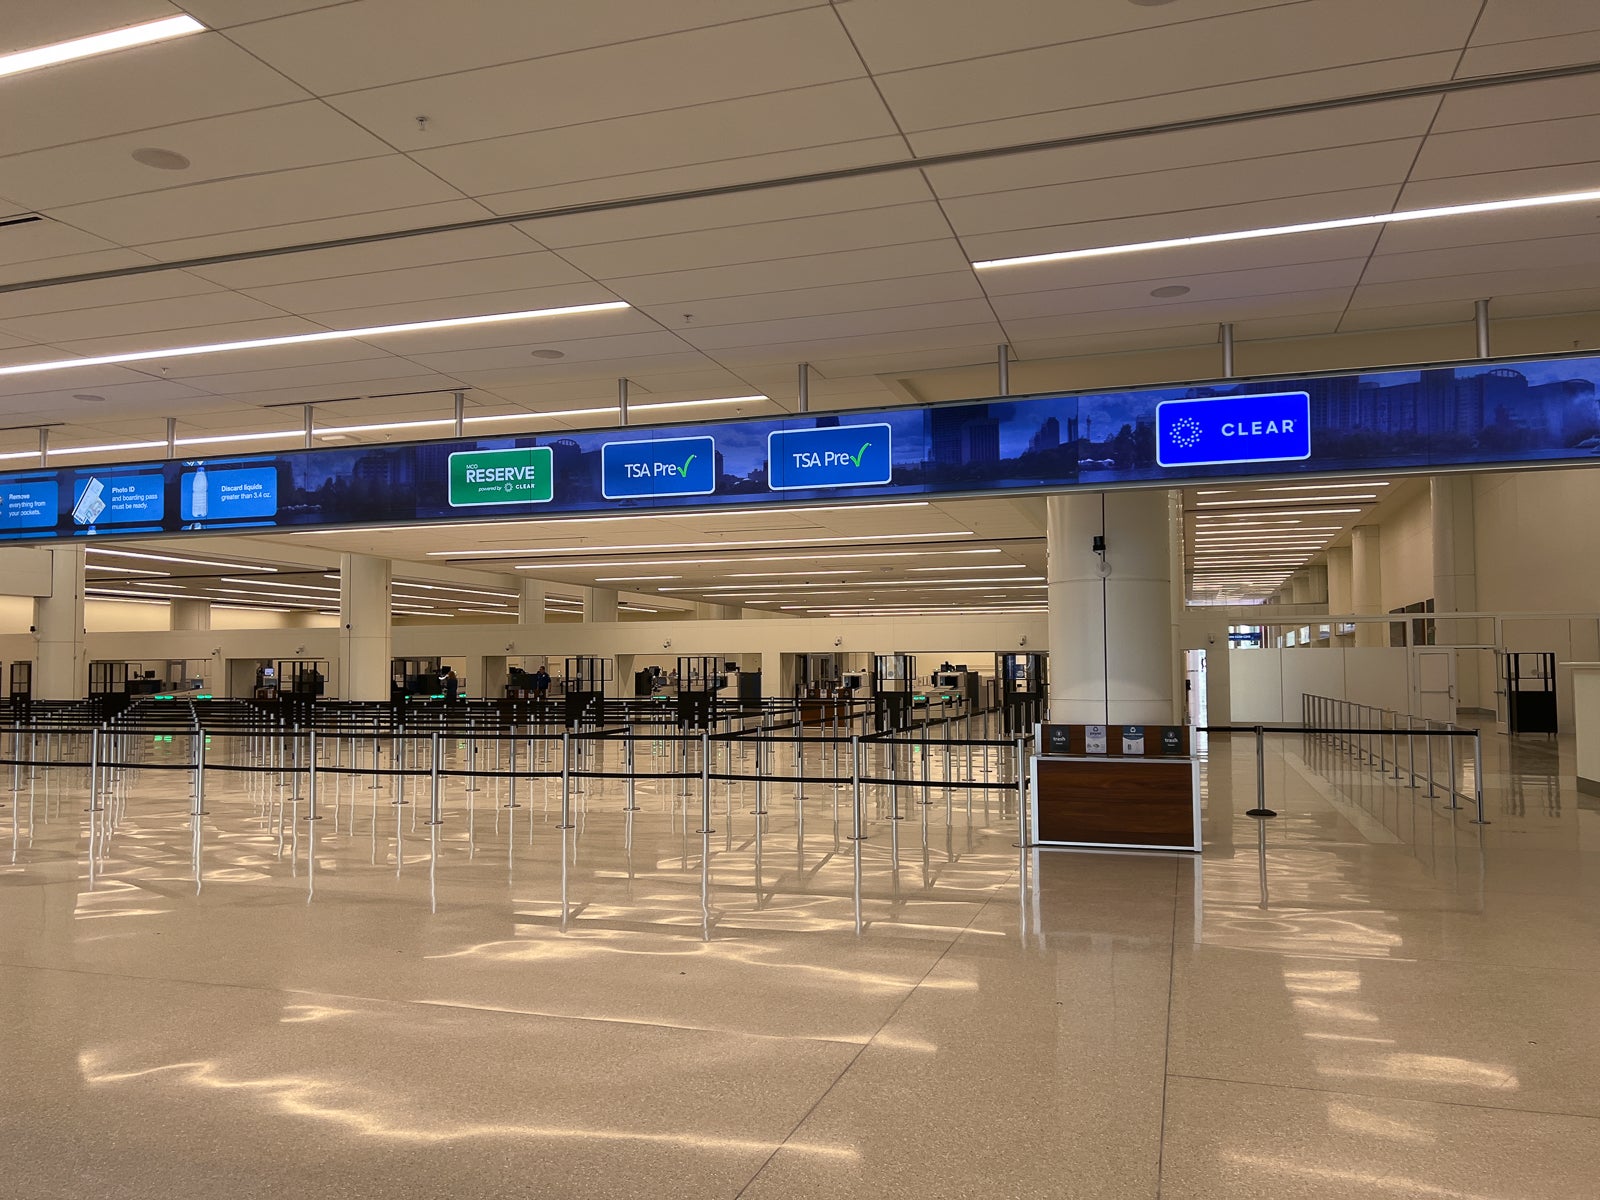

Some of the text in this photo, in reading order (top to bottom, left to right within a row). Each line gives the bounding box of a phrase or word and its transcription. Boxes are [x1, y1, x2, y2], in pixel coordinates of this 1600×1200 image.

[1221, 420, 1295, 437] CLEAR
[792, 451, 850, 468] TSA Pre
[466, 466, 535, 483] RESERVE
[624, 462, 677, 478] TSA Pre
[221, 483, 263, 492] Discard liquids
